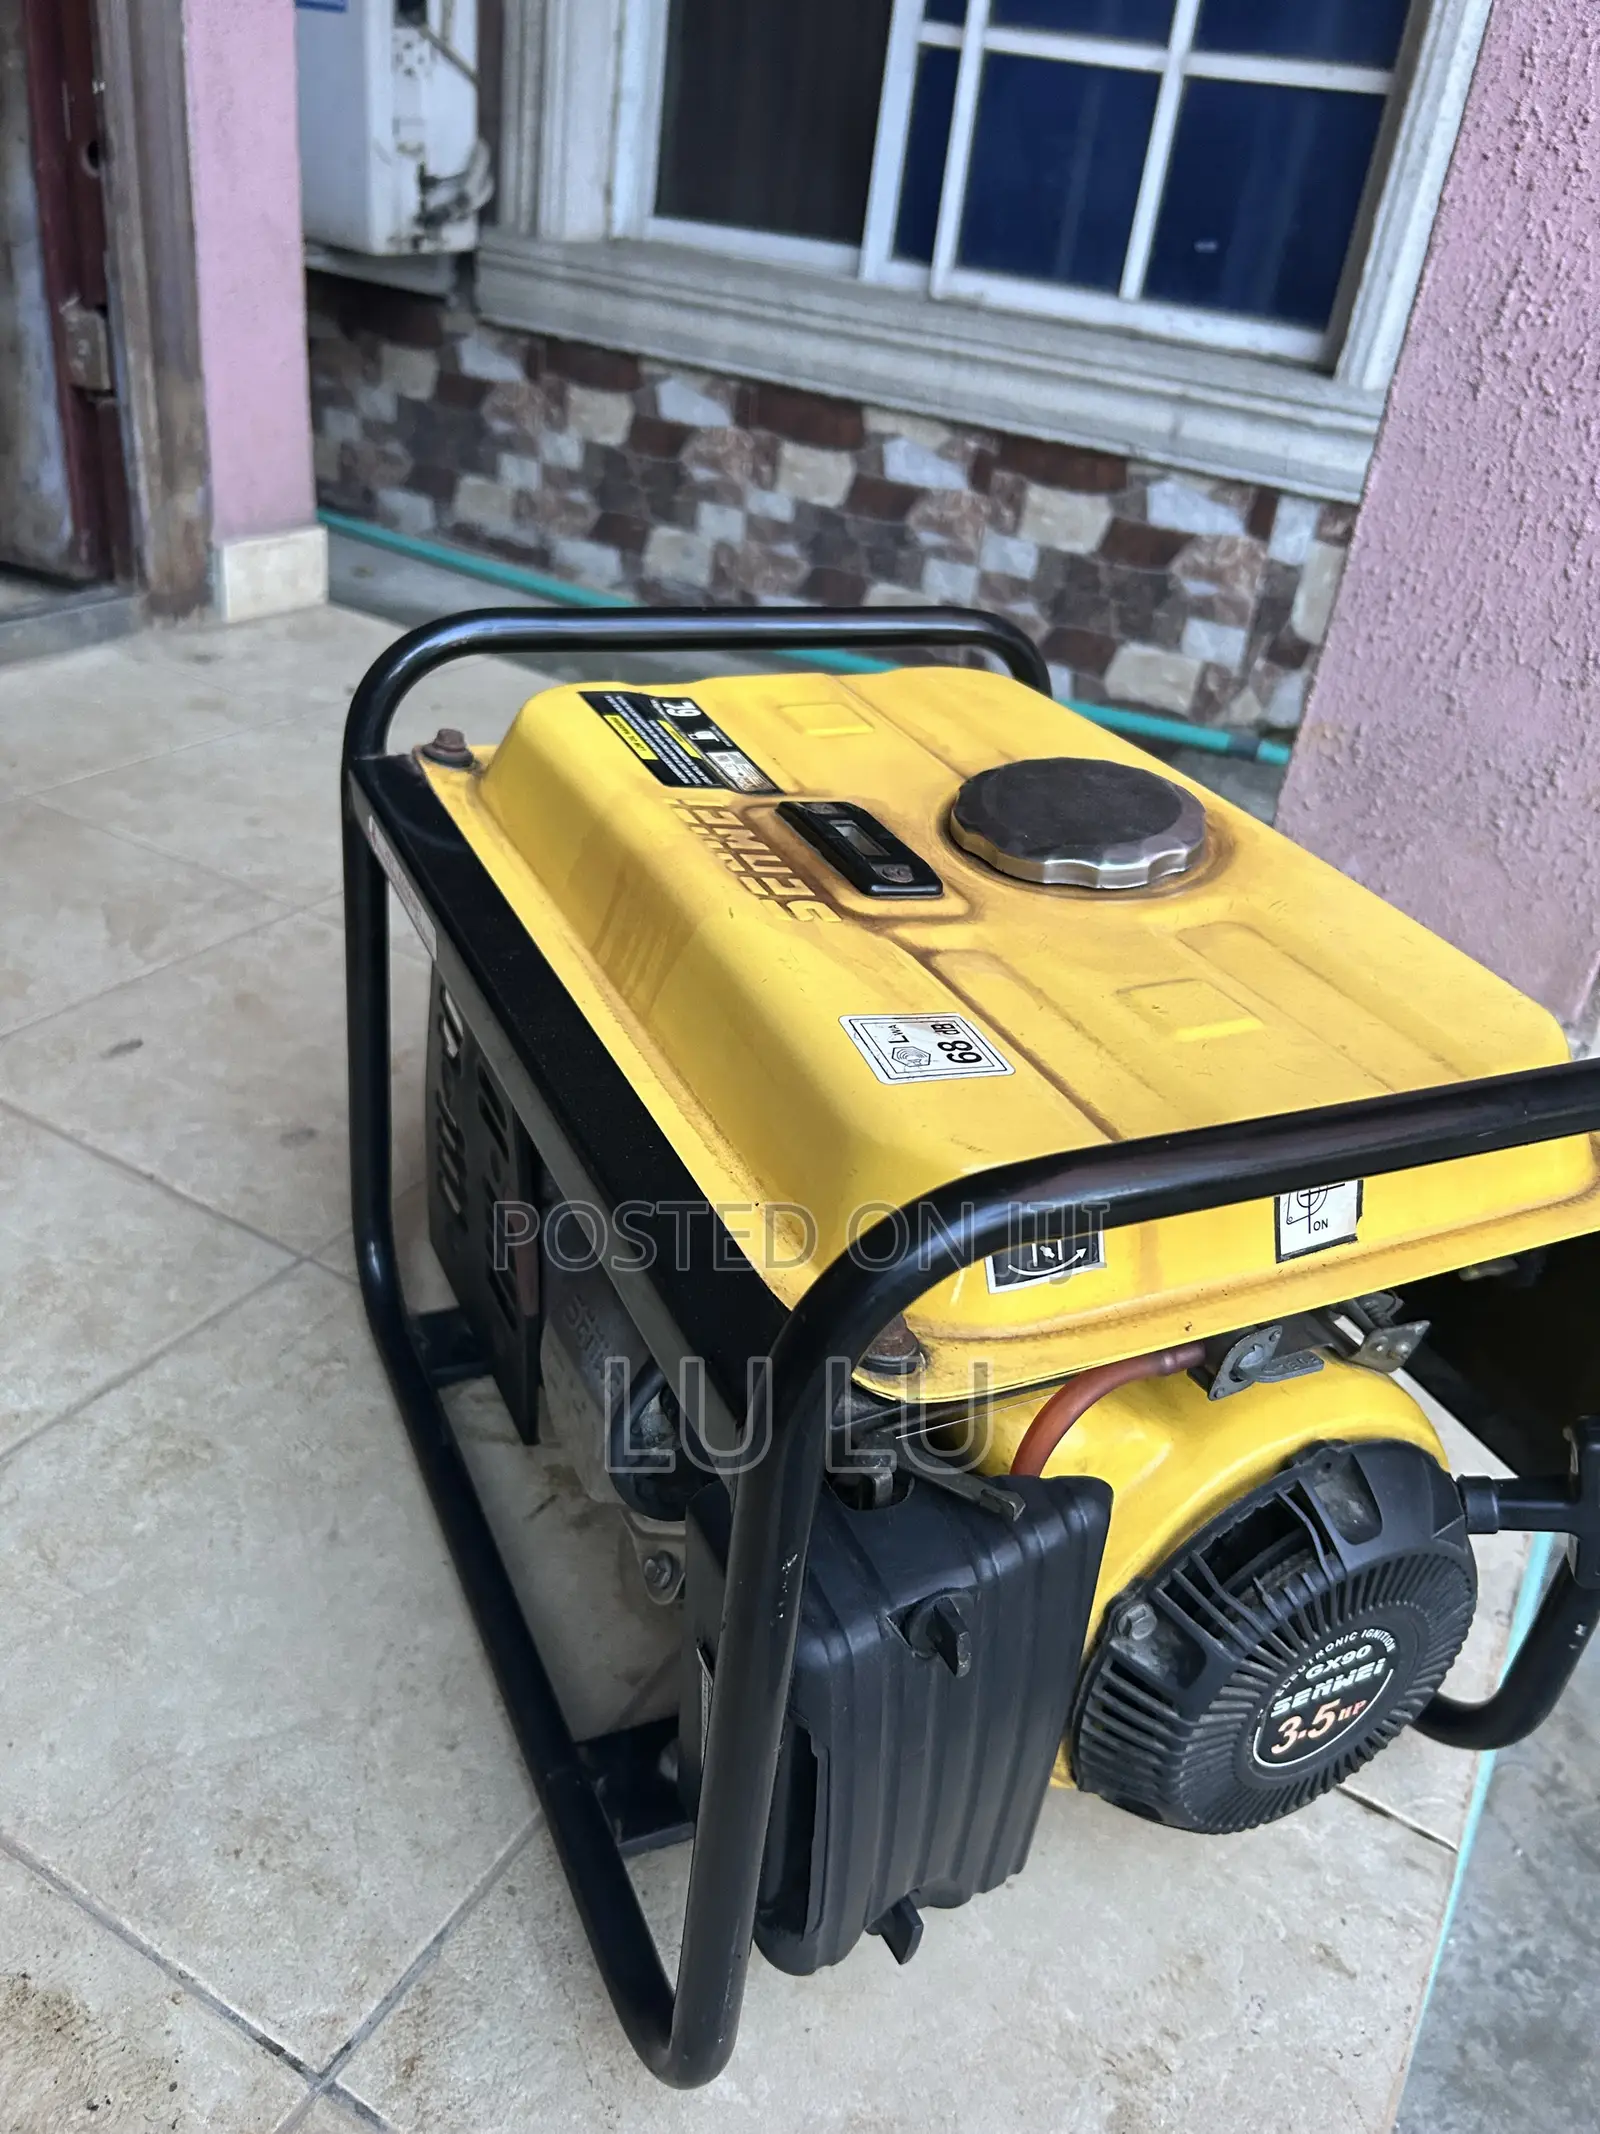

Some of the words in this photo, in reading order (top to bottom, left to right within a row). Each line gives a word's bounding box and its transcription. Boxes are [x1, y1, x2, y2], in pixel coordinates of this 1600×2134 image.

[930, 1023, 961, 1036] dB
[937, 1040, 982, 1064] 68
[1313, 1217, 1329, 1231] ON
[1360, 1628, 1396, 1653] IGNITION
[1305, 1644, 1373, 1680] GX90
[1270, 1657, 1387, 1718] SENWEI
